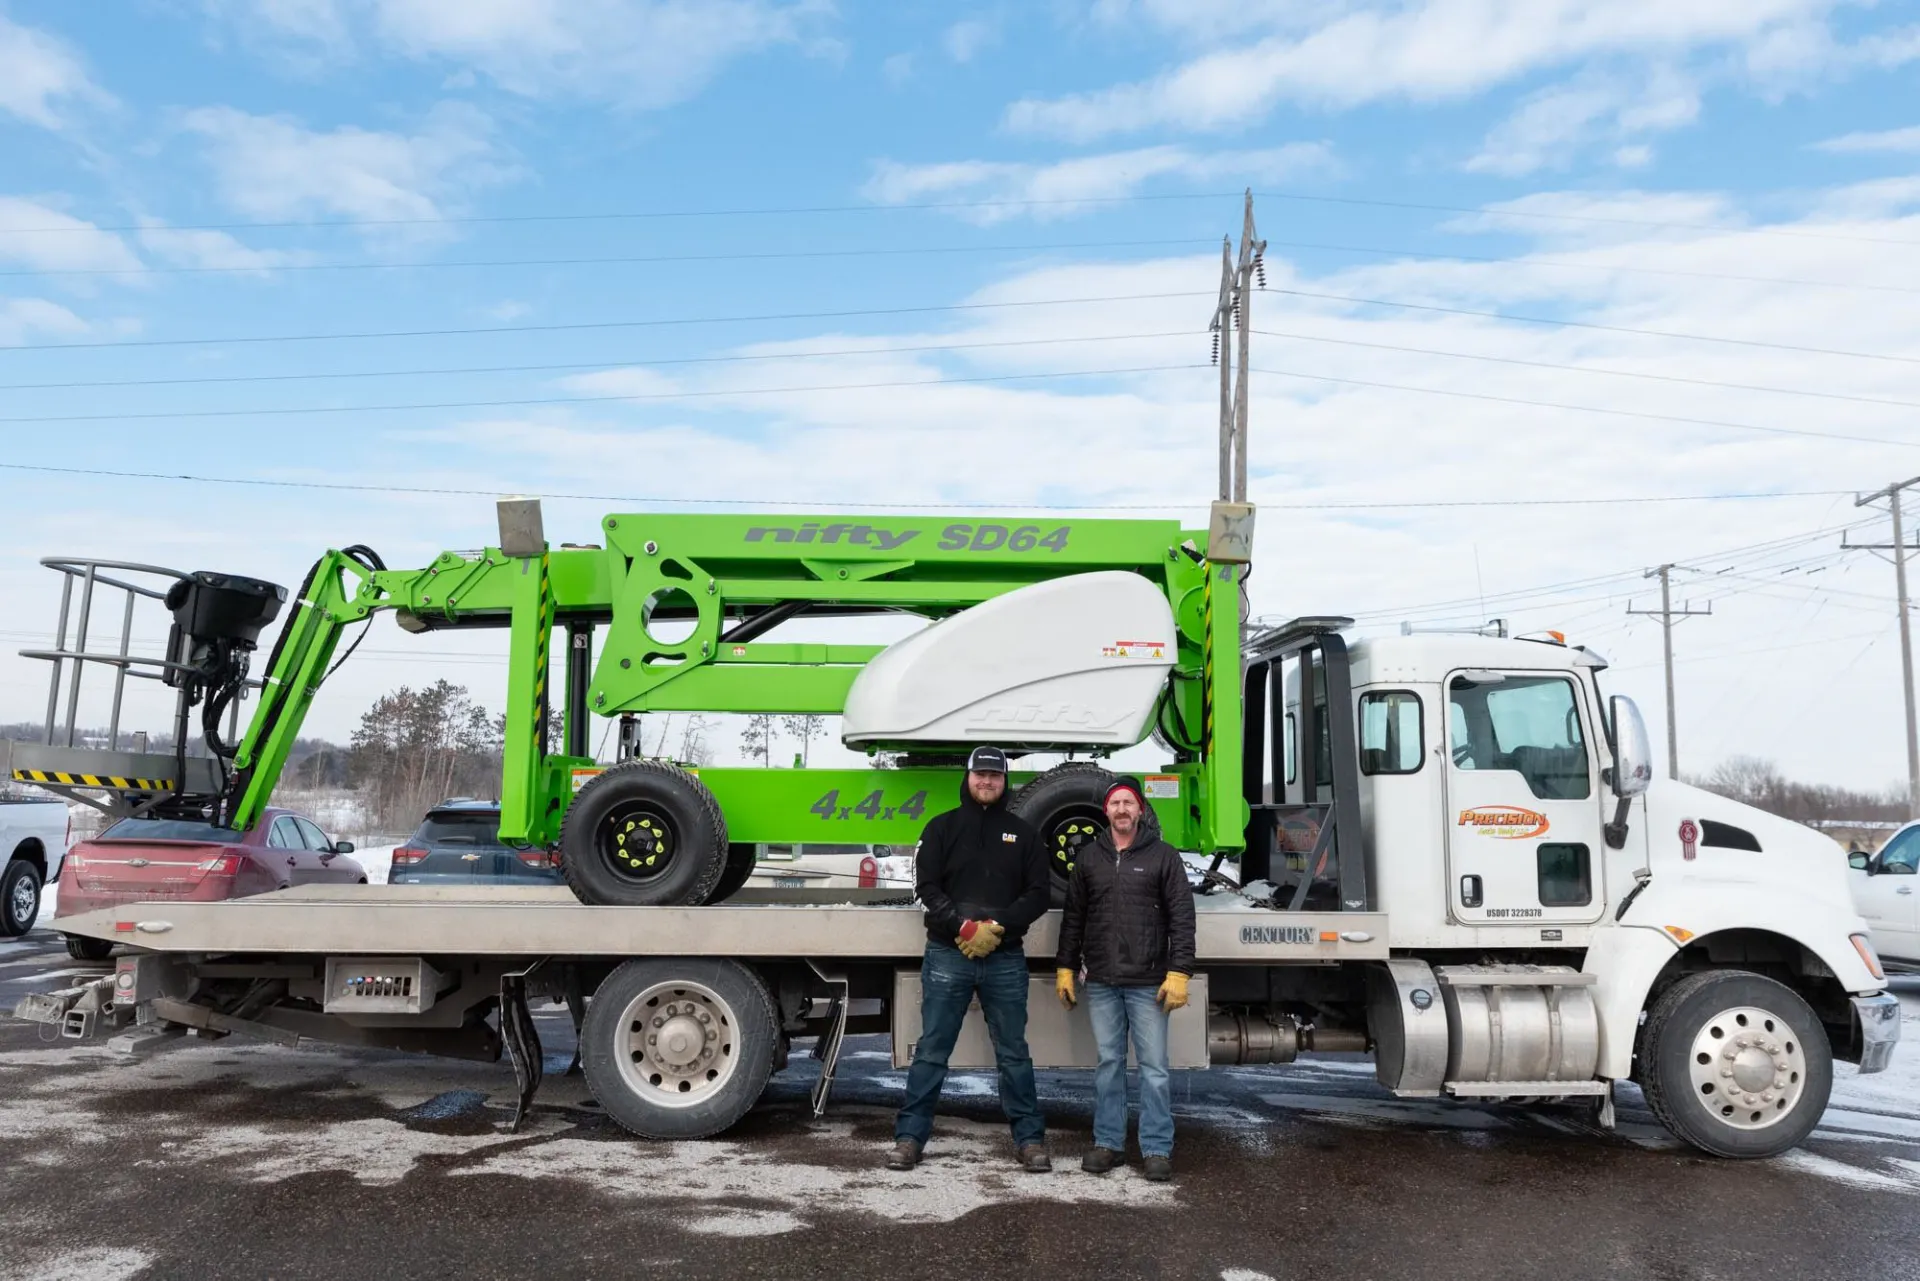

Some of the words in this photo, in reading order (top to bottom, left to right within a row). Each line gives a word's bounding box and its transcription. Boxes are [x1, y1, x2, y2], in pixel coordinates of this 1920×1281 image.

[744, 523, 922, 550] nifty
[937, 524, 1071, 552] SD64
[968, 704, 1136, 729] nifty
[1458, 810, 1546, 826] PRECISION
[1002, 833, 1018, 842] CAT
[1487, 909, 1509, 917] USDOT
[1240, 925, 1315, 944] CENTURY
